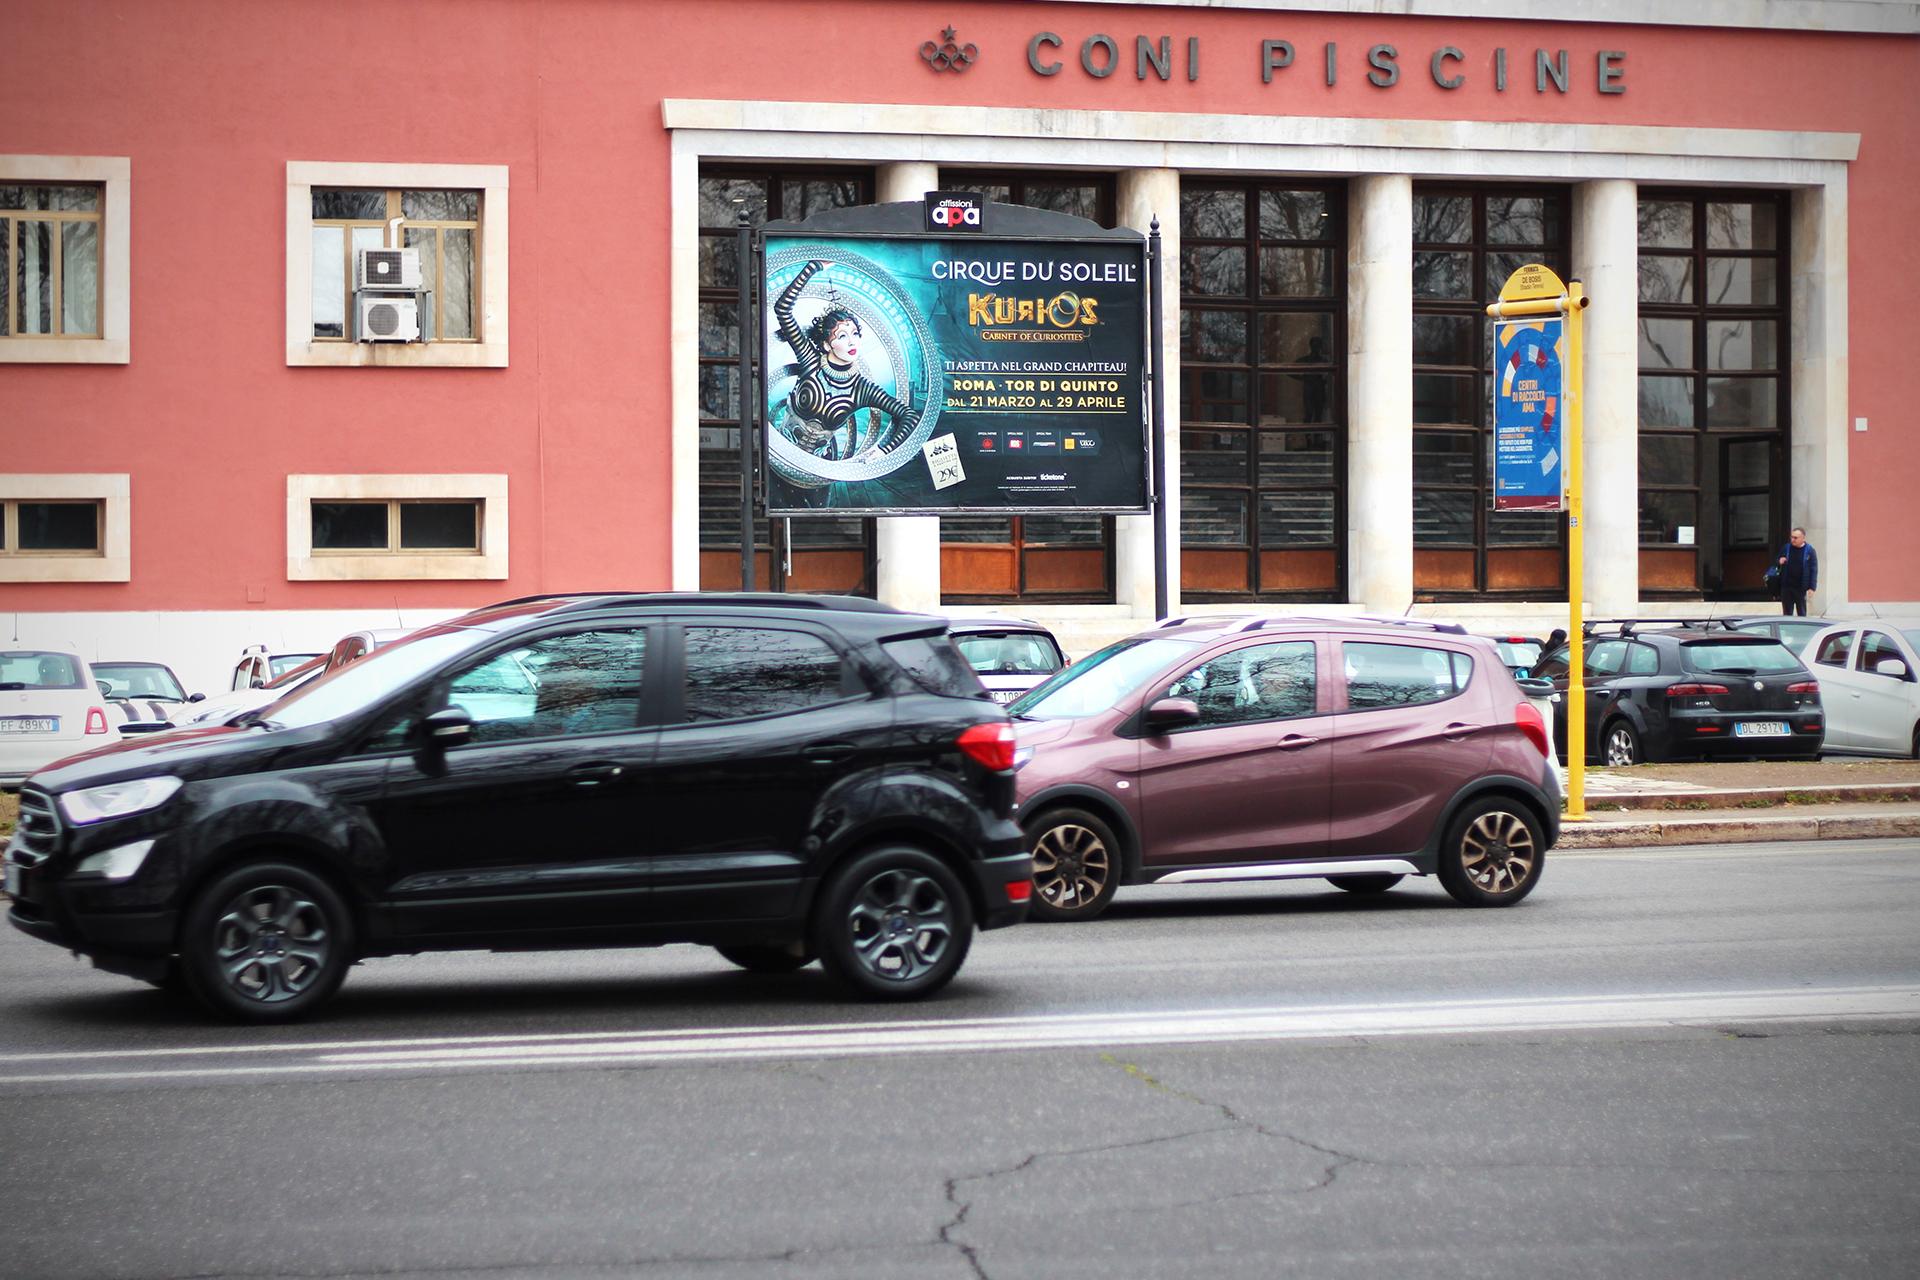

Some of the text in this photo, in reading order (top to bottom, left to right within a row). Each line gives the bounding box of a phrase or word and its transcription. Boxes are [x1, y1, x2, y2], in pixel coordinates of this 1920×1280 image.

[1027, 31, 1627, 95] CONI PISCINE
[939, 200, 973, 208] affissioni
[932, 206, 980, 228] apa
[932, 260, 1136, 287] CIRQUE DU SOLEIL
[982, 331, 1083, 342] CABINET OF CURIOSITIES
[945, 361, 1127, 372] TI ASPETTA NEL GRAND CHAPITEAU!
[953, 379, 1119, 392] ROMA TOR DI QUINTO
[947, 396, 1126, 408] DAL 21 MARZO AL 29 APRILE
[1742, 723, 1753, 734] DL
